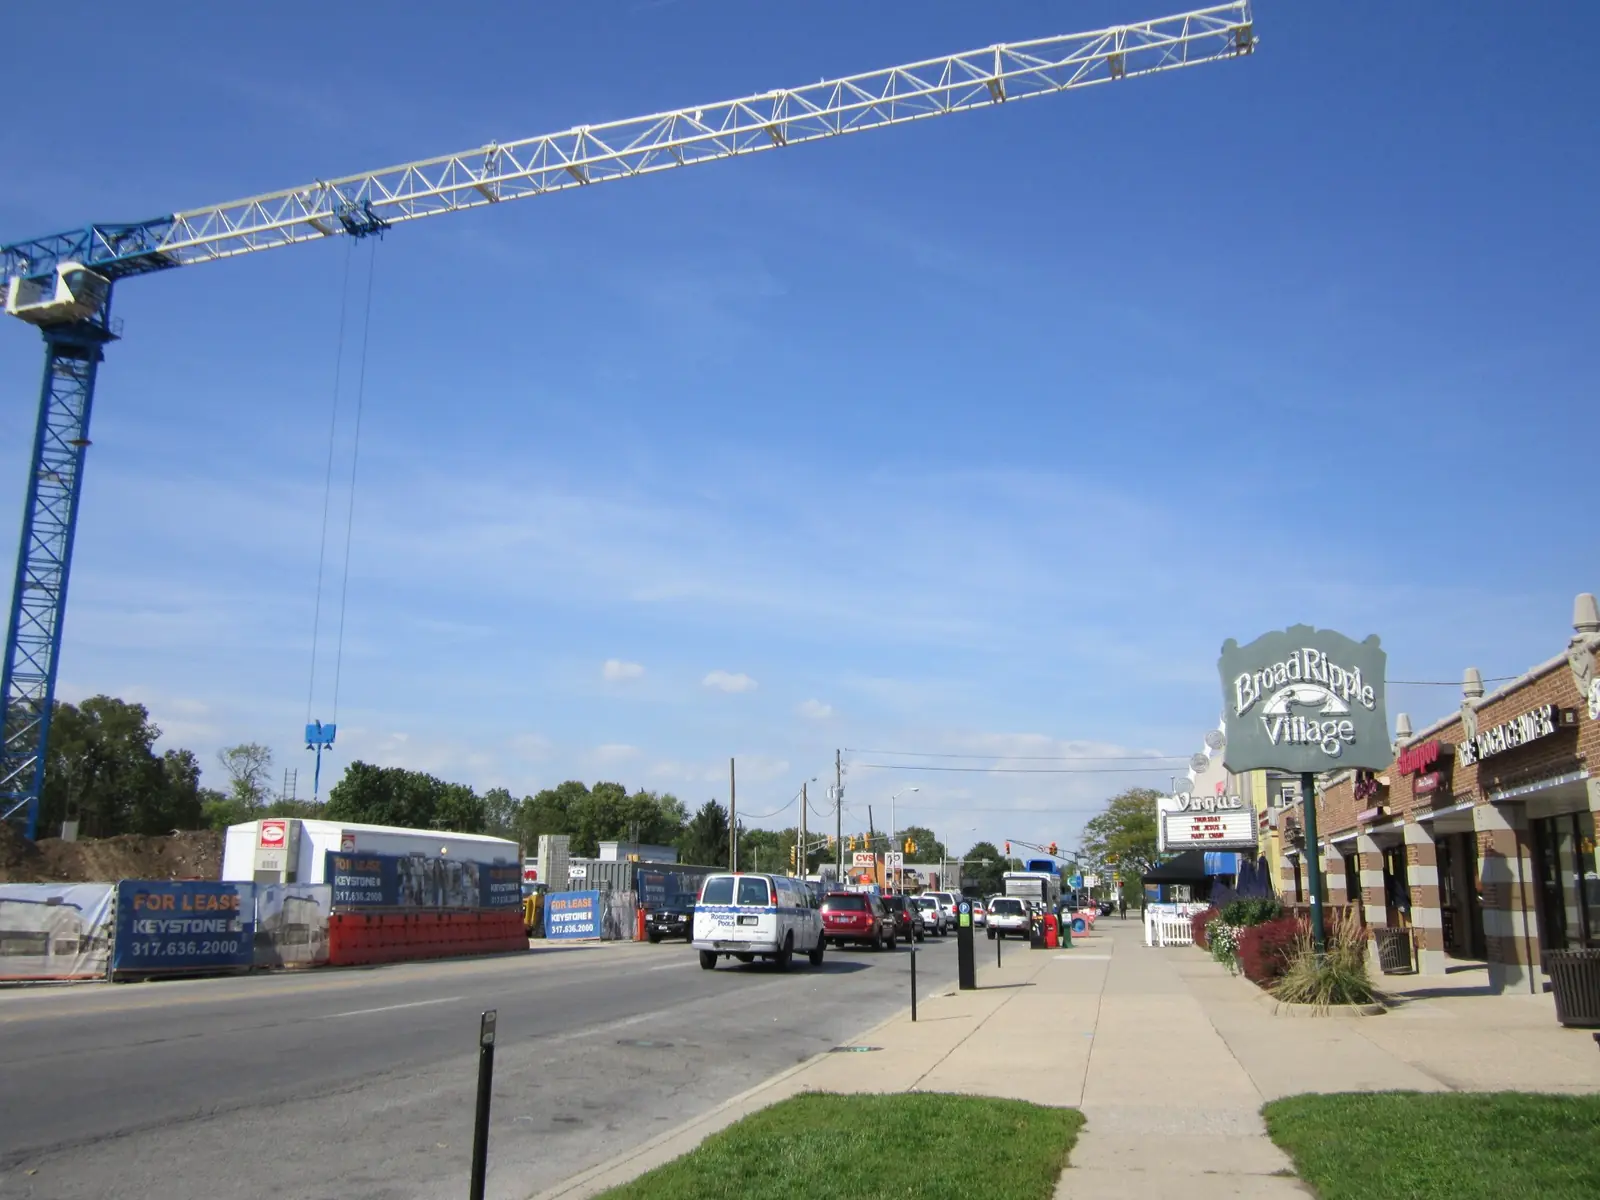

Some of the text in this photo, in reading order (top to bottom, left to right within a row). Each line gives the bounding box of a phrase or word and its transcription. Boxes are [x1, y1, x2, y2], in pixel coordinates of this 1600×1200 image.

[1235, 648, 1374, 717] Broad Ripple
[1260, 716, 1354, 755] Village
[1476, 724, 1507, 760] YOGA
[1506, 704, 1555, 749] CENTER
[856, 854, 875, 862] CVS
[335, 875, 376, 887] KEYSTONE
[133, 894, 240, 911] FOR LEASE
[551, 897, 592, 910] FOR LEASE
[551, 911, 588, 923] KEYSTONE
[133, 919, 226, 934] KEYSTONE
[551, 923, 594, 935] 317.636.2000
[131, 941, 238, 956] 317.636.2000
